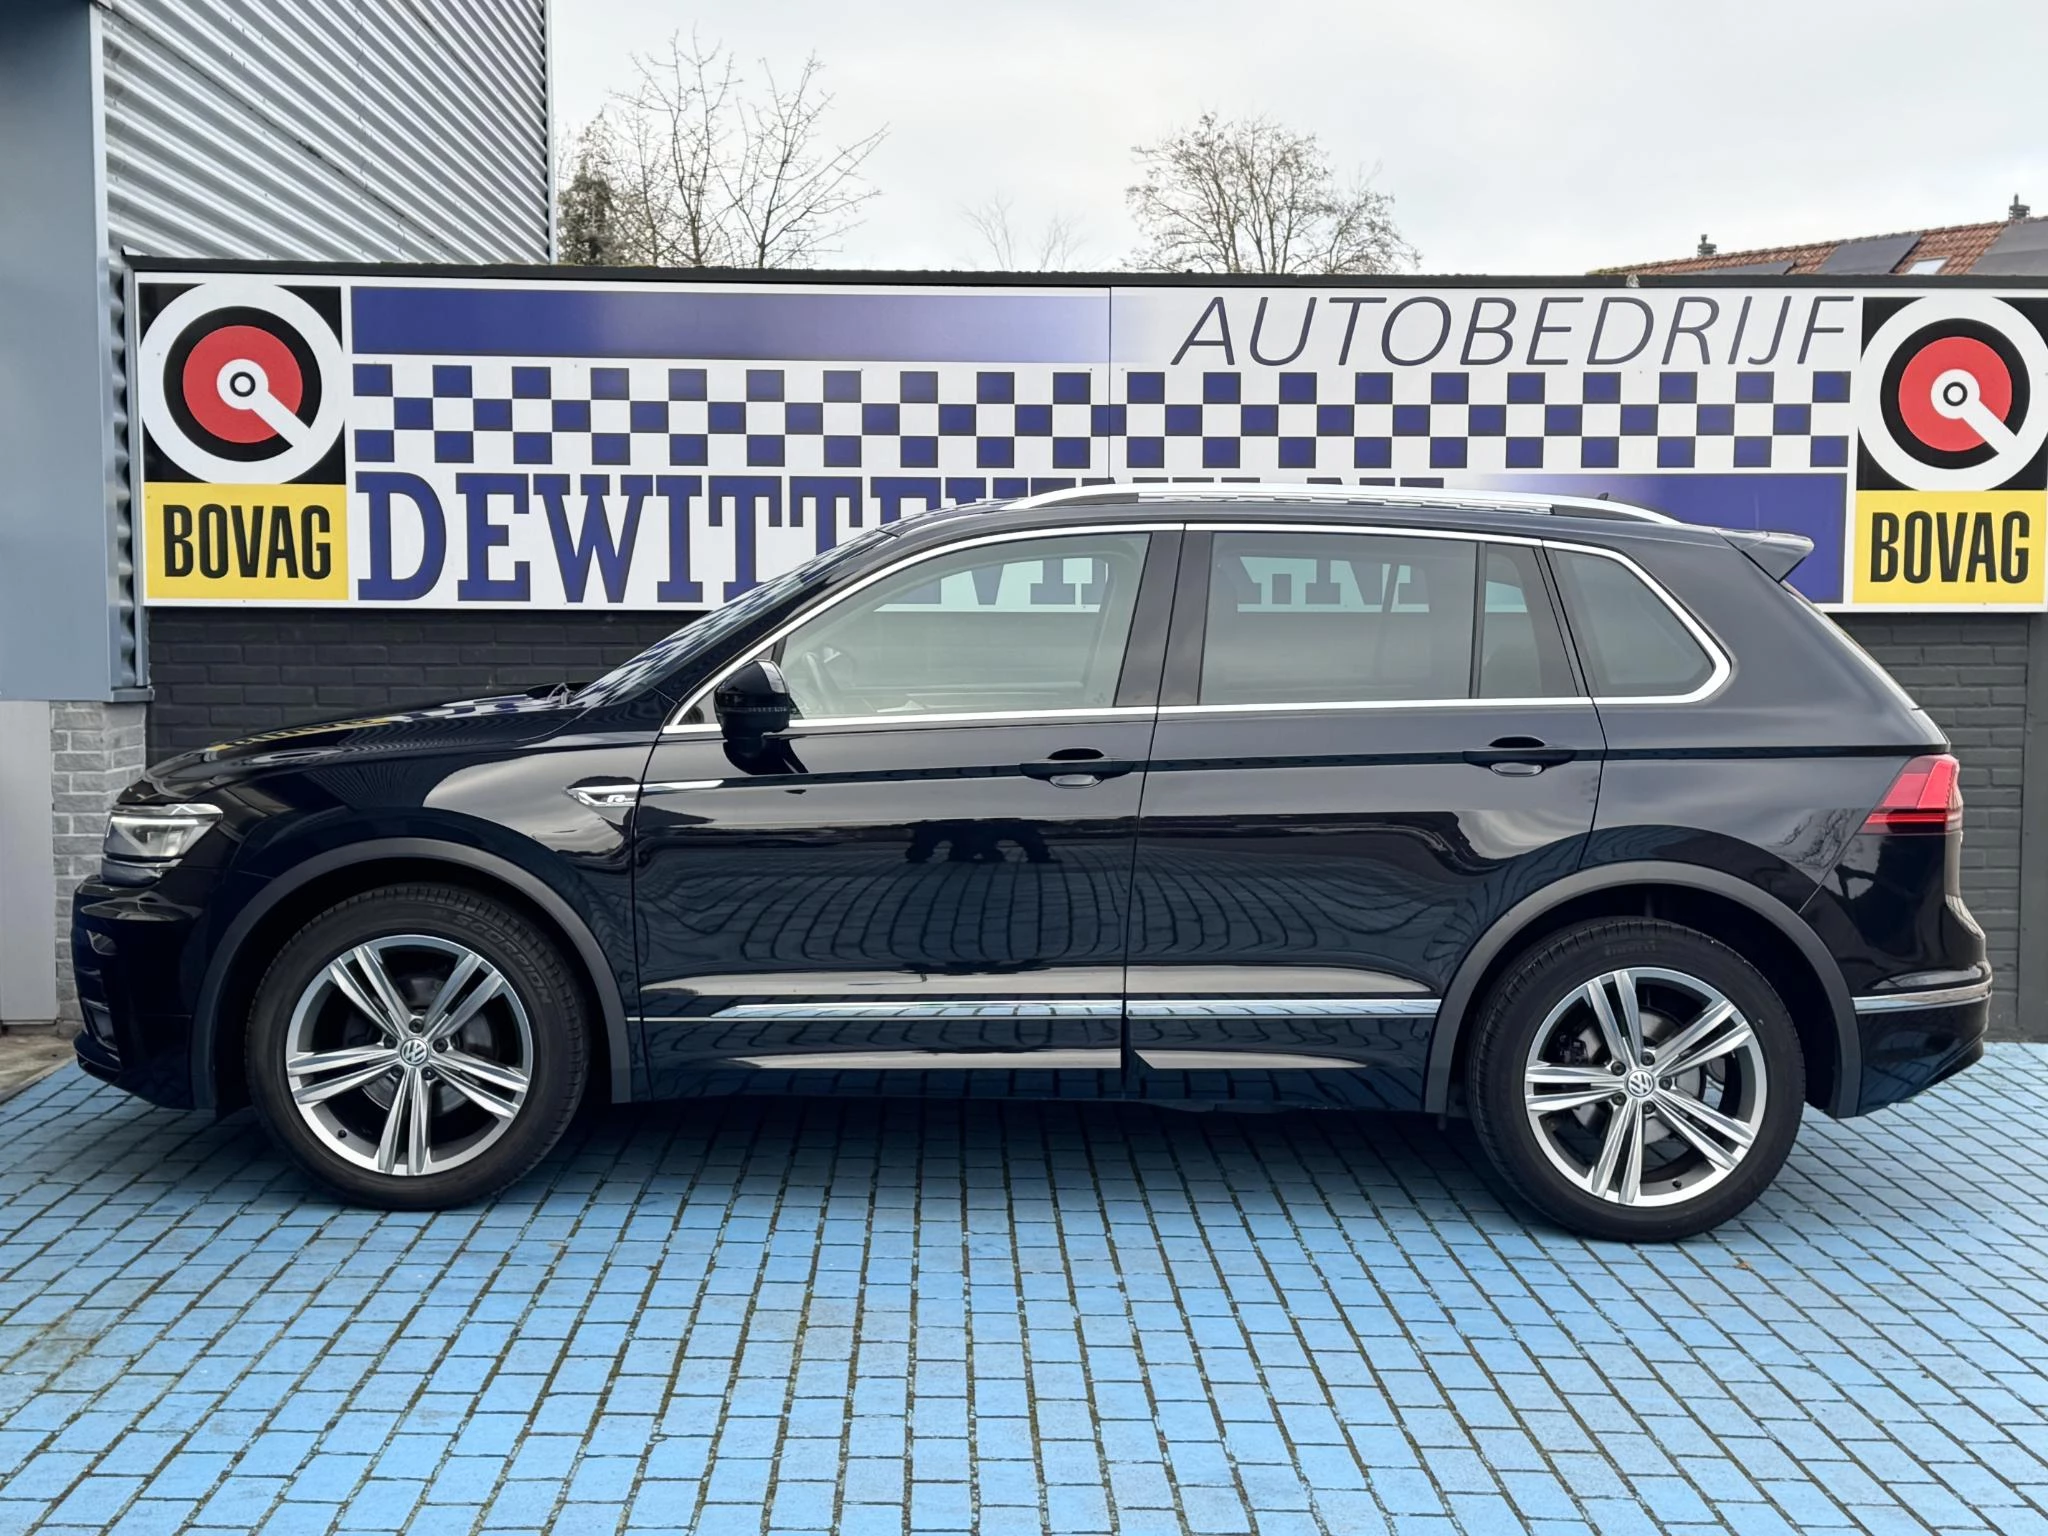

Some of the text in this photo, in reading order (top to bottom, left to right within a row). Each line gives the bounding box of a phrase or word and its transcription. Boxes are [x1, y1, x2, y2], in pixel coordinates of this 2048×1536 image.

[1170, 296, 1854, 367] AUTOBEDRIJF
[163, 503, 332, 580] BOVAG
[1870, 510, 2030, 584] BOVAG
[451, 913, 552, 1004] SCORPION
